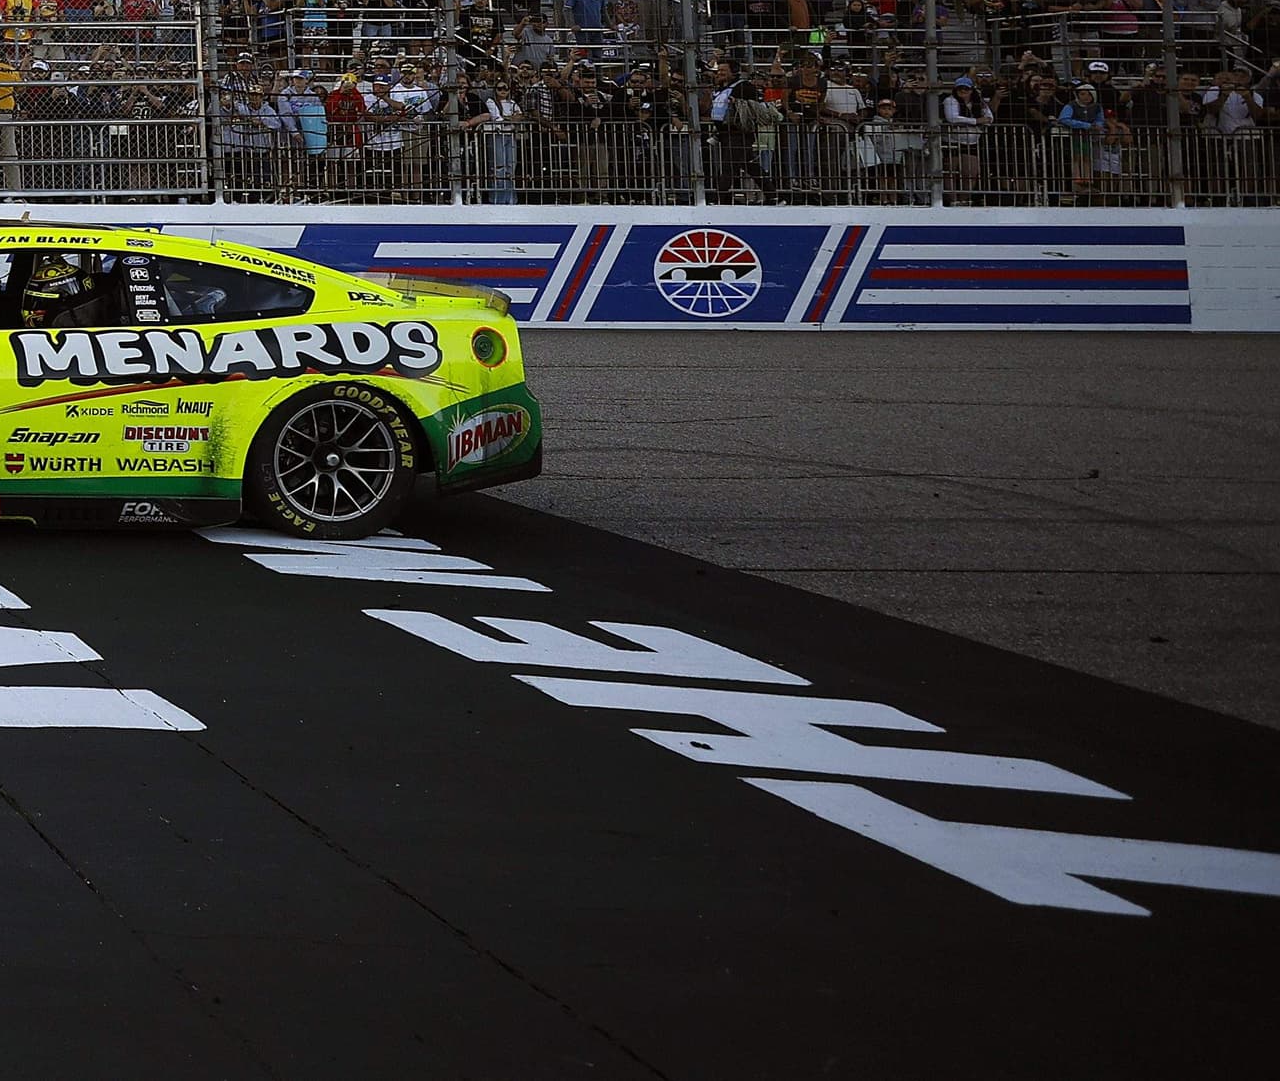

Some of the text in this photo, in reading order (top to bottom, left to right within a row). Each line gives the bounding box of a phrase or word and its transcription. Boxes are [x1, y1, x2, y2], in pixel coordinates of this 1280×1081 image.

[36, 236, 103, 245] BLANEY
[238, 254, 316, 281] ADVANCE
[347, 291, 386, 302] DEX
[16, 321, 440, 386] MENARDS
[81, 407, 115, 417] KIDDE
[122, 402, 170, 415] Richmond
[124, 425, 210, 441] DISCOUNT
[333, 385, 414, 468] GOODYEAR
[7, 427, 101, 446] Snap-on
[447, 410, 523, 474] LIBMAN
[147, 442, 185, 451] TIRE
[116, 458, 216, 473] WABASH
[268, 491, 317, 533] EAGLE
